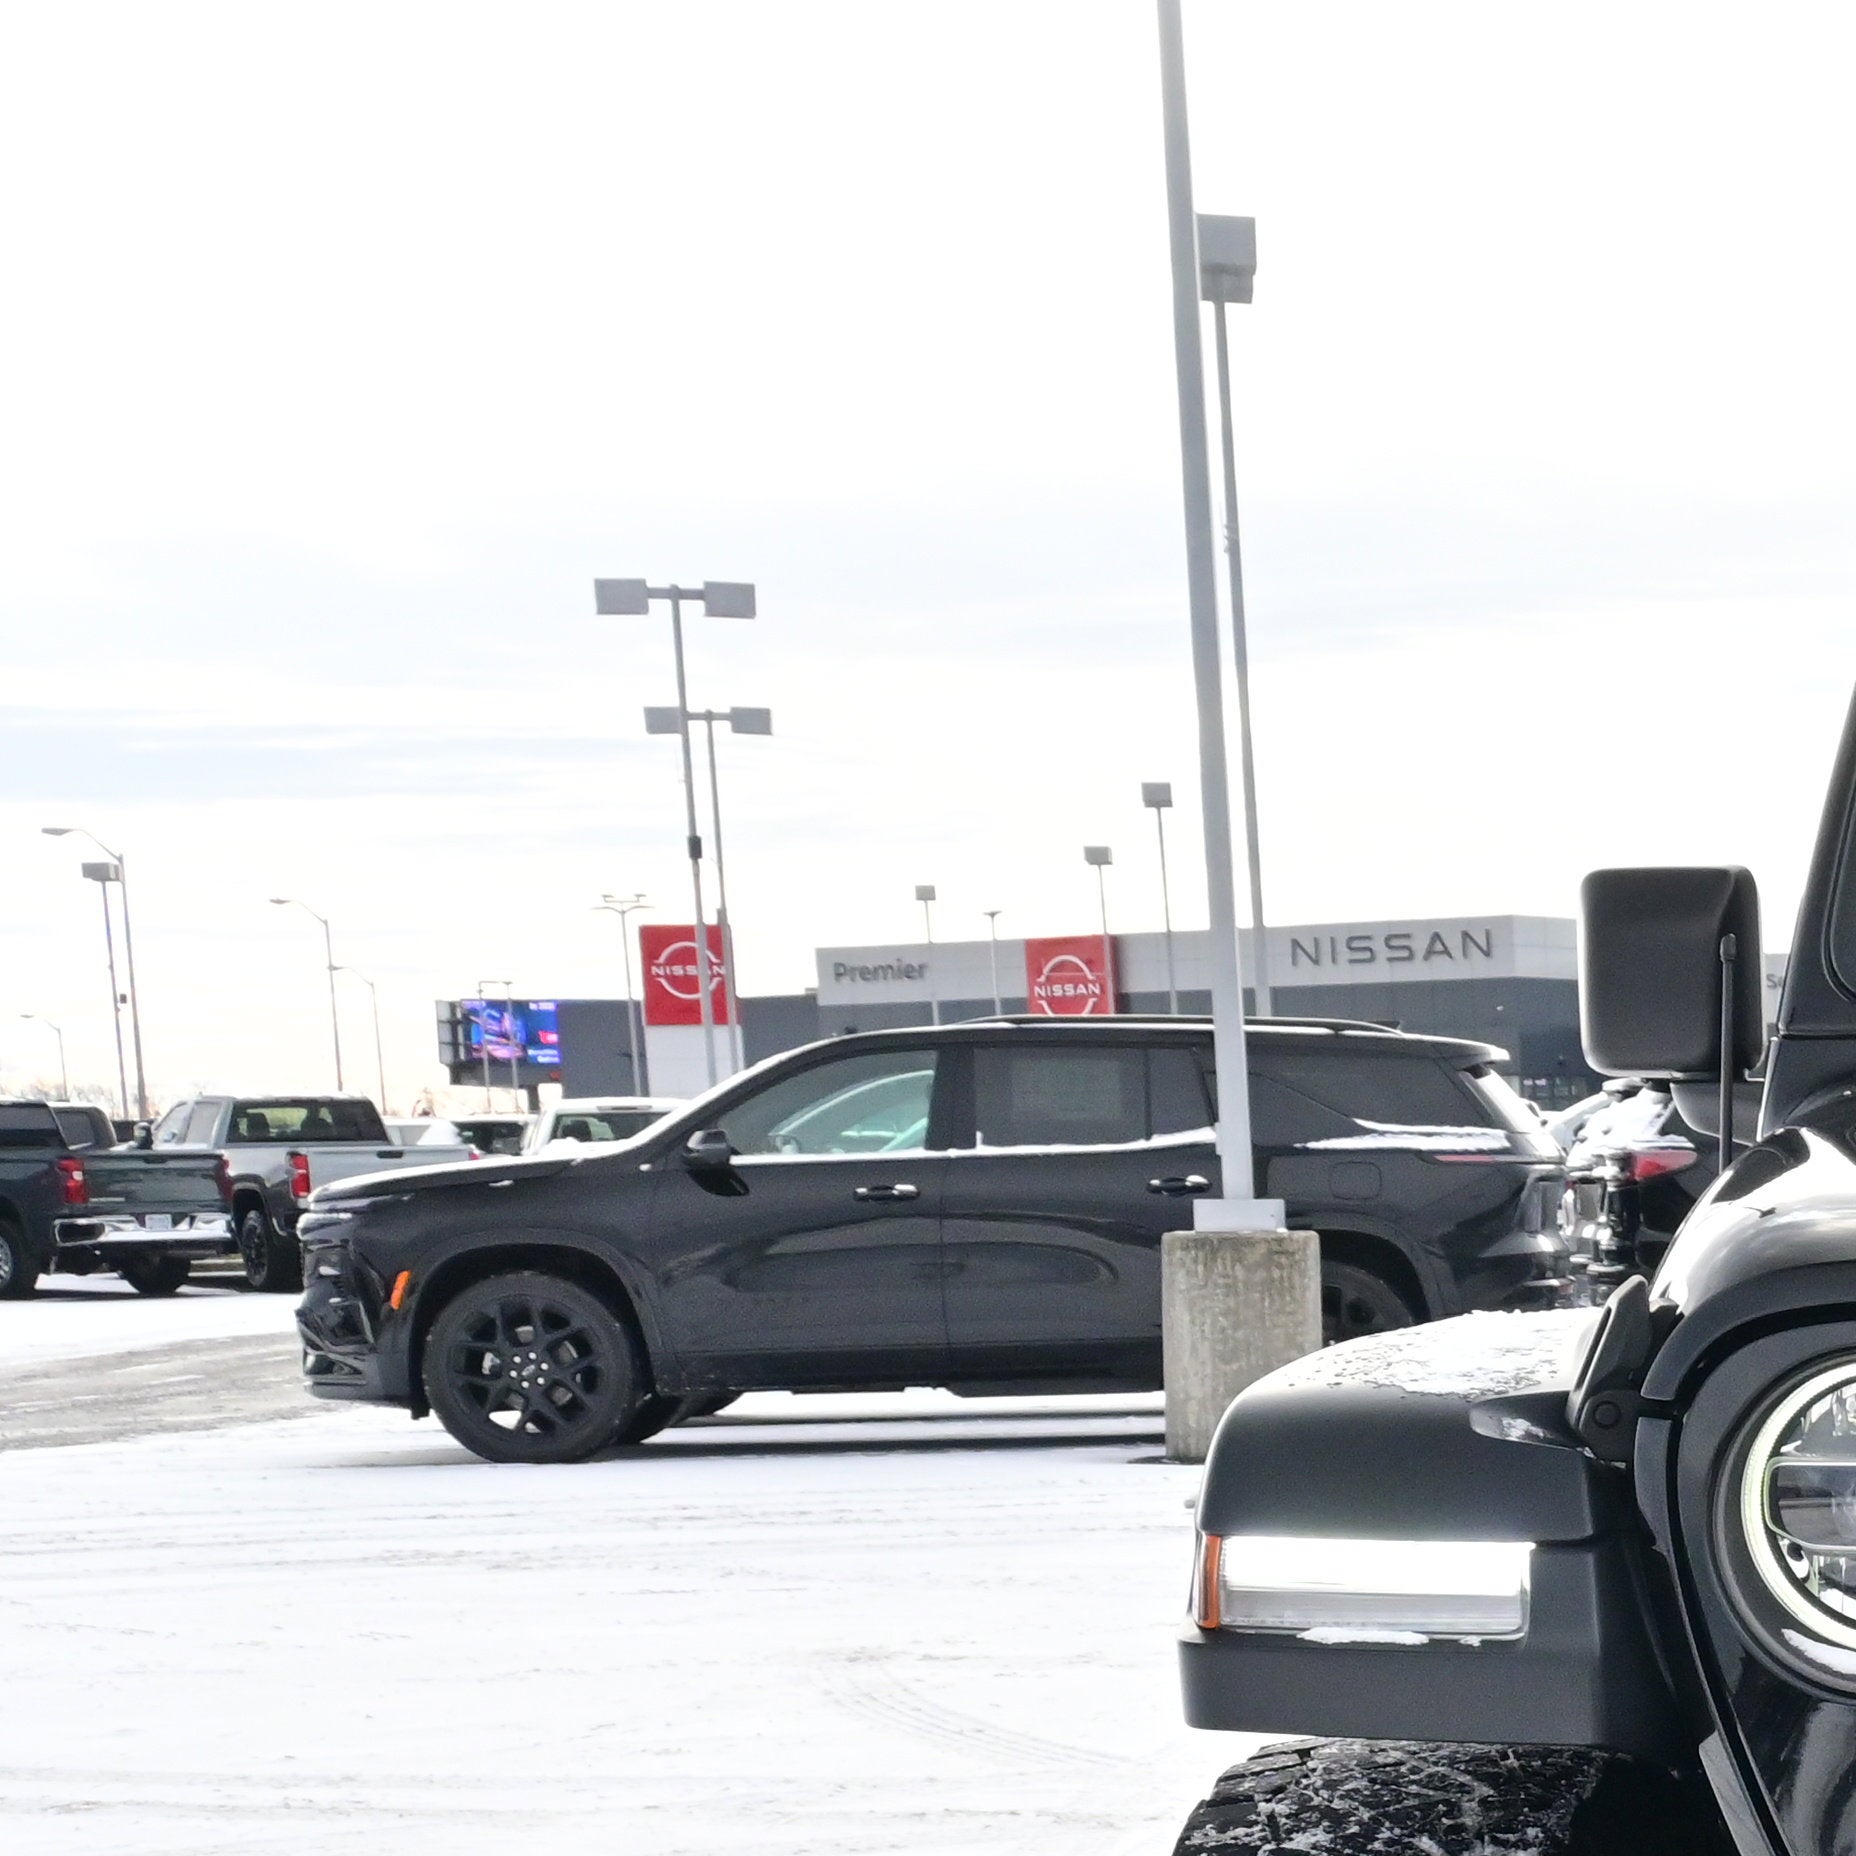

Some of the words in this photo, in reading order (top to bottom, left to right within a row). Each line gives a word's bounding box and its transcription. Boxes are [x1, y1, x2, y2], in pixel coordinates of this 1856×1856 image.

[1291, 928, 1492, 967] NISSAN
[651, 964, 726, 976] NISSN
[833, 959, 928, 983] Premier
[1034, 983, 1100, 998] NISSAN
